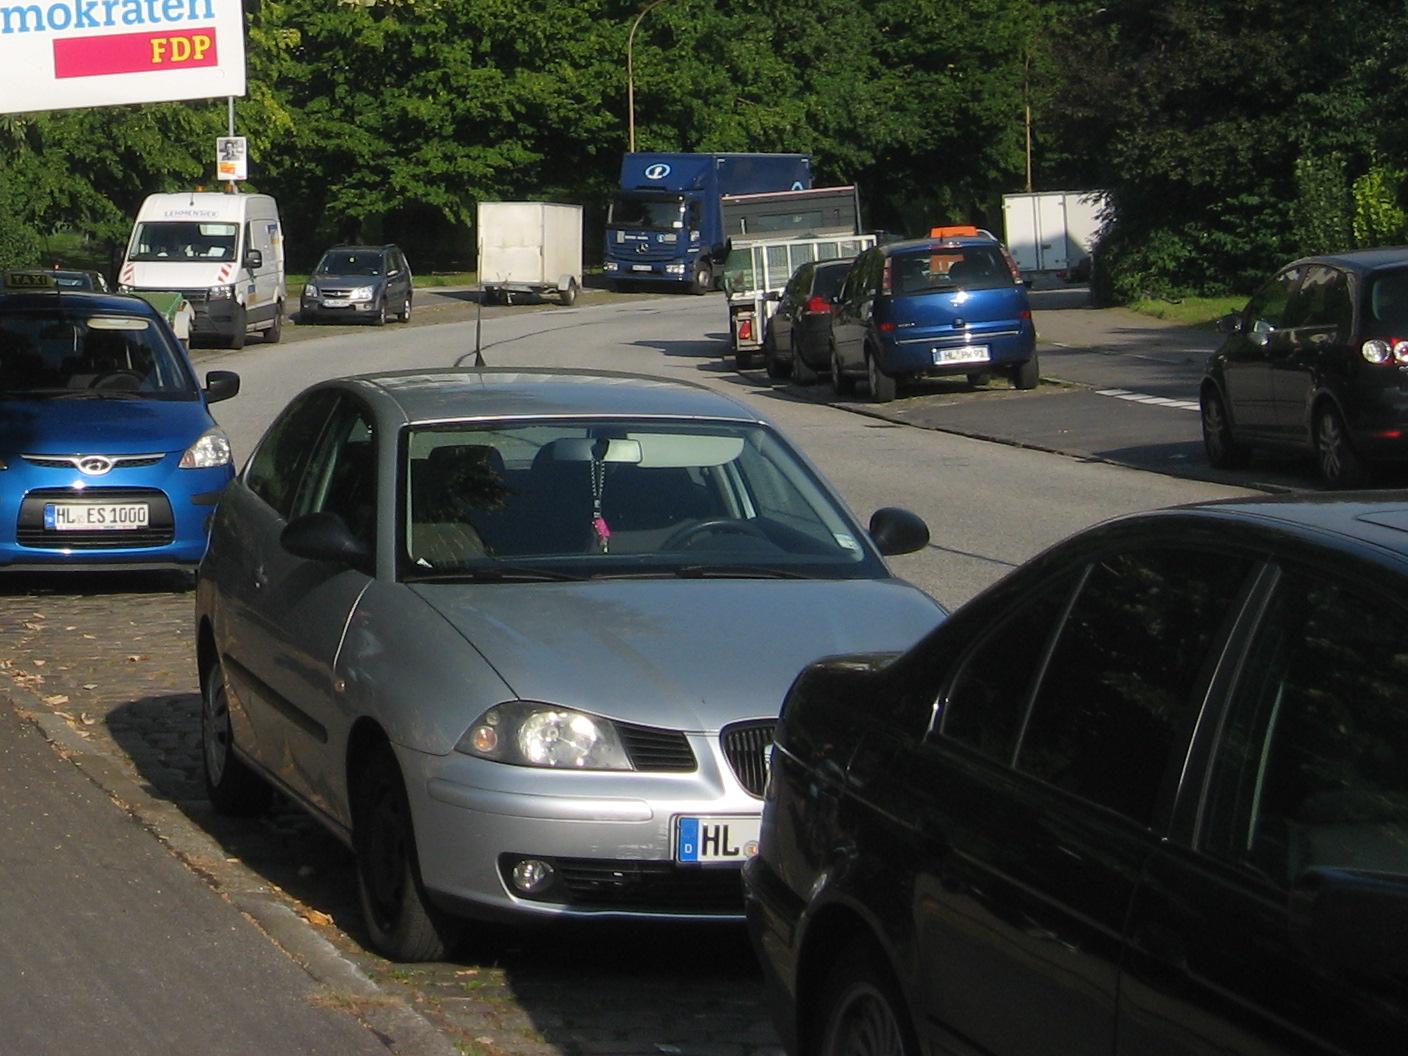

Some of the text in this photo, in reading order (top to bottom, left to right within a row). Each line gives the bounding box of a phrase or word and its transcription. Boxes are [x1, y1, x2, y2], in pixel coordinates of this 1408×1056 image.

[150, 34, 212, 64] FDP
[56, 507, 146, 524] HL ES 1000
[701, 824, 740, 857] HL
